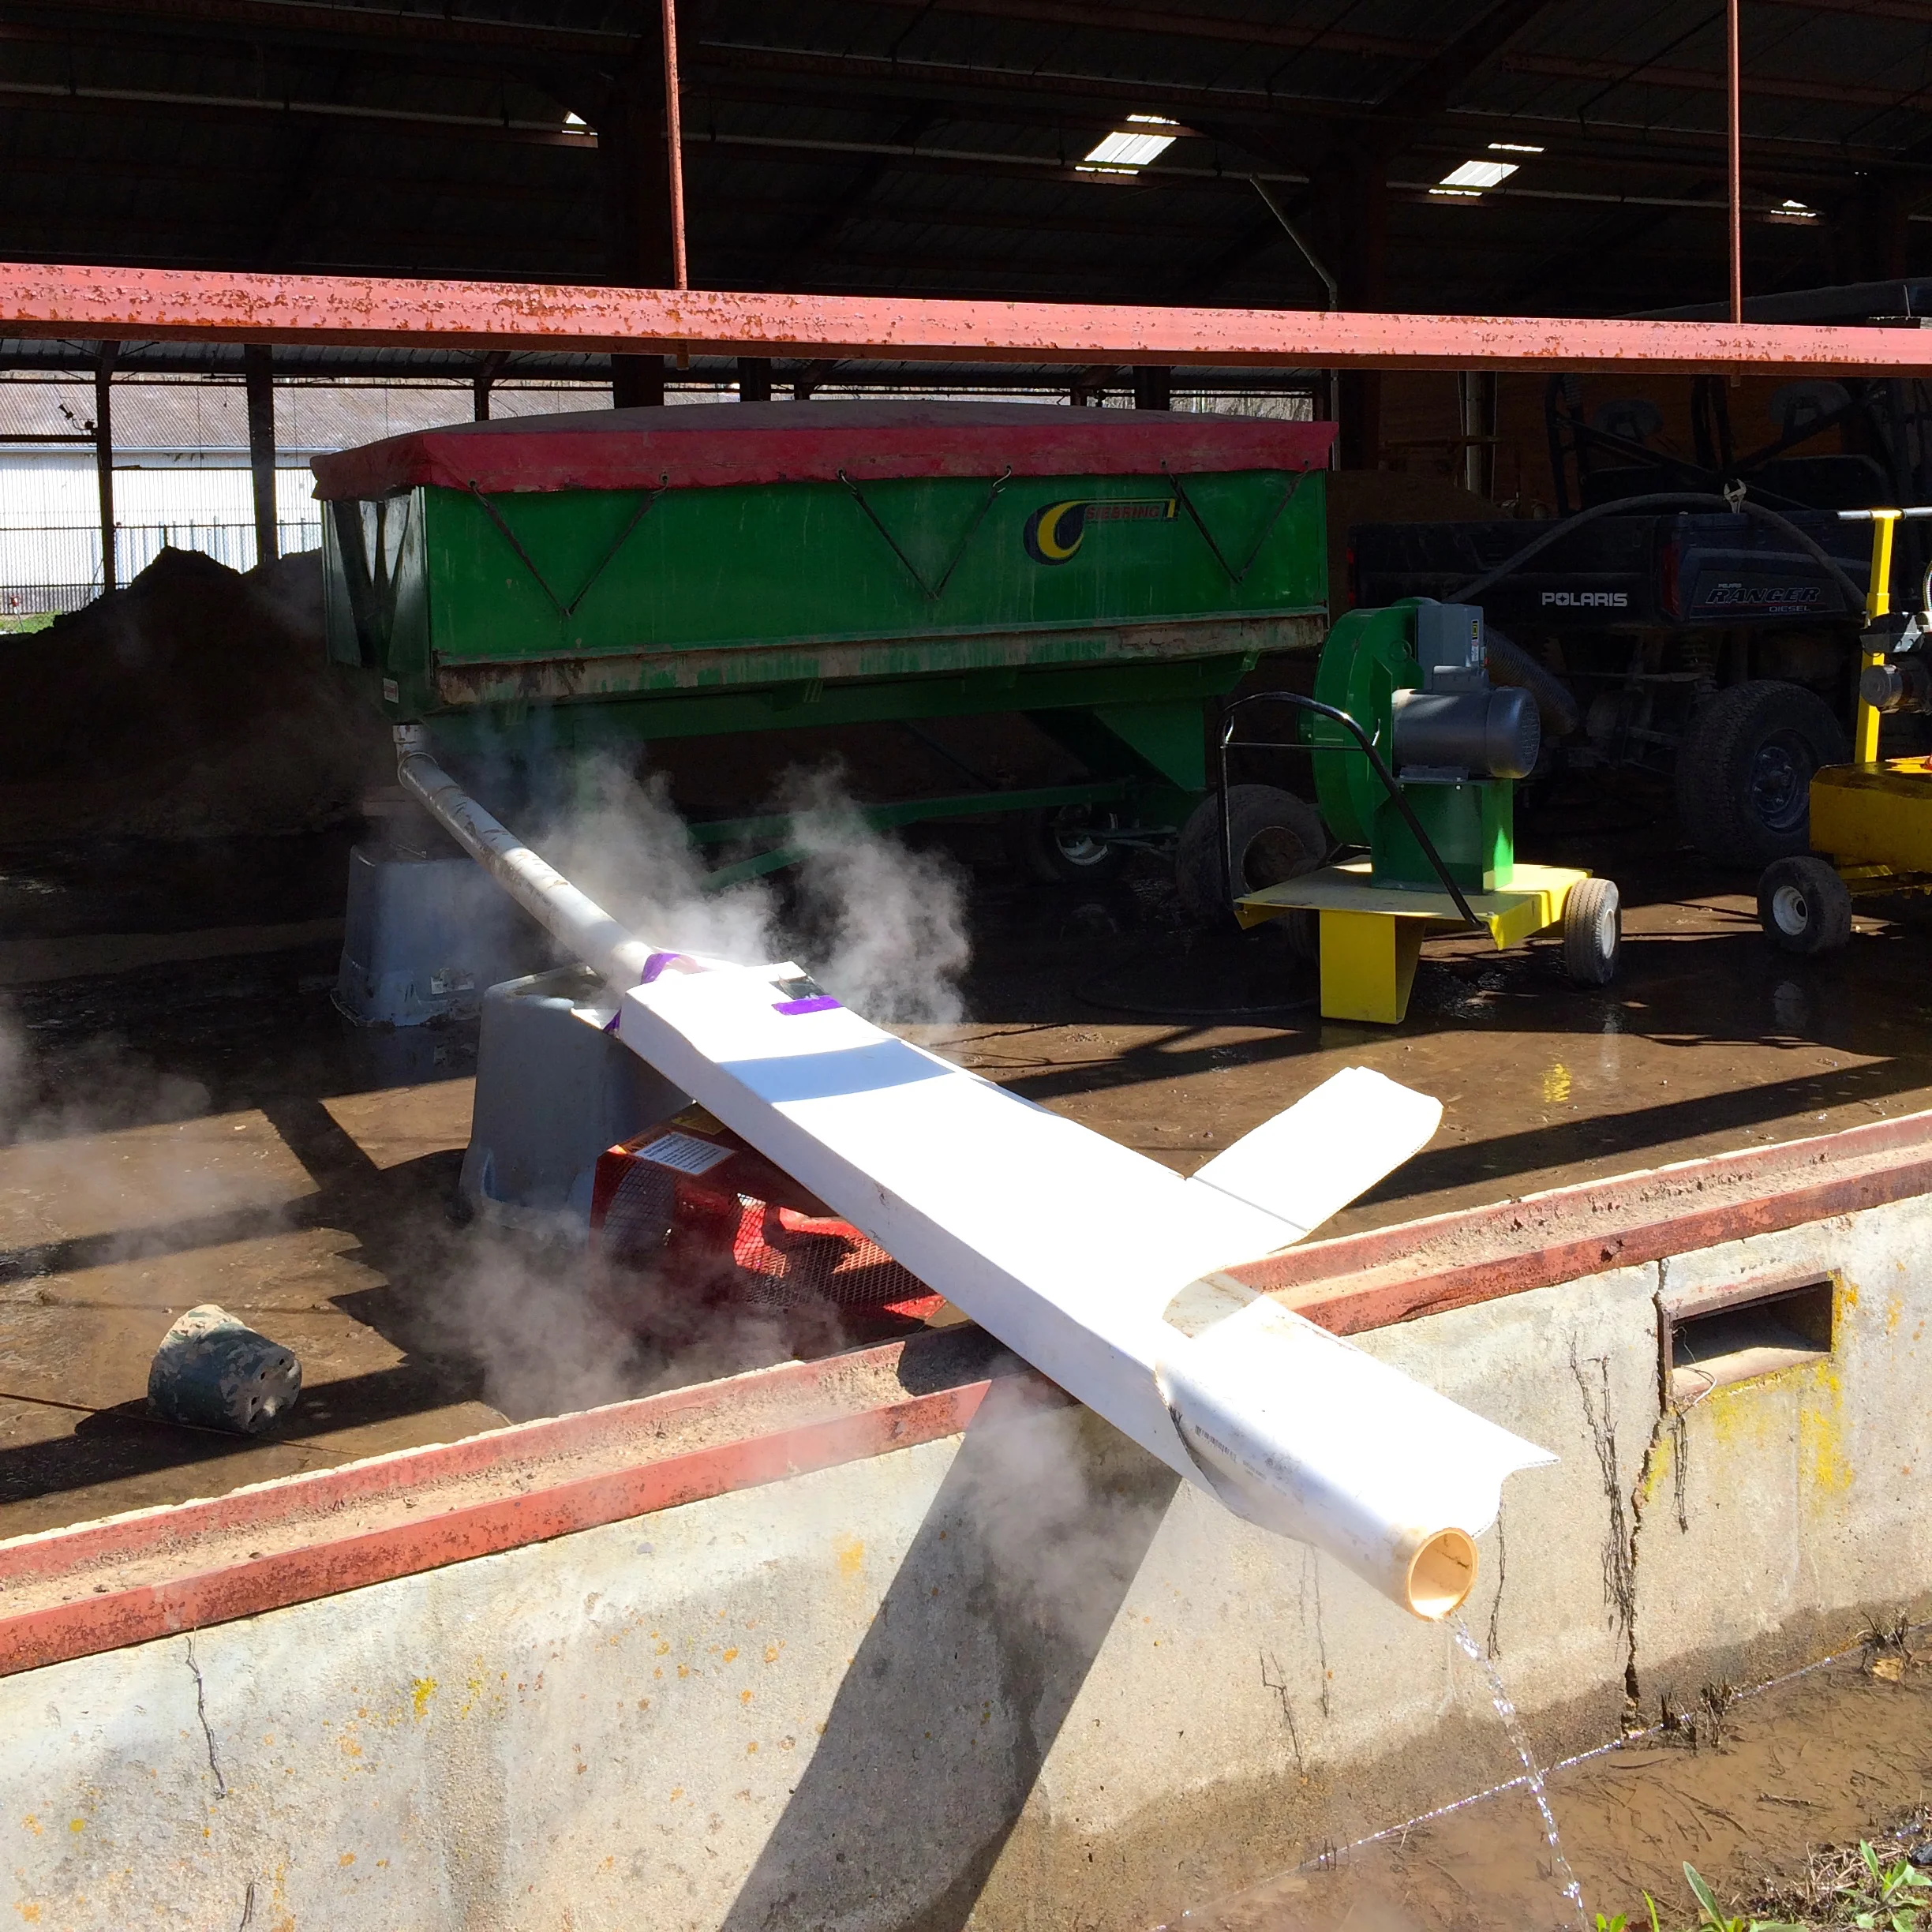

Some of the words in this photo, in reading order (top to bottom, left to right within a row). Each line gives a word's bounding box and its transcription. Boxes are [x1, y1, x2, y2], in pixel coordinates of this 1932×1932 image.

[1086, 506, 1159, 519] SIEBRING
[1541, 592, 1627, 607] POLARIS
[1705, 586, 1821, 605] RANGER
[1769, 605, 1810, 613] DIESEL
